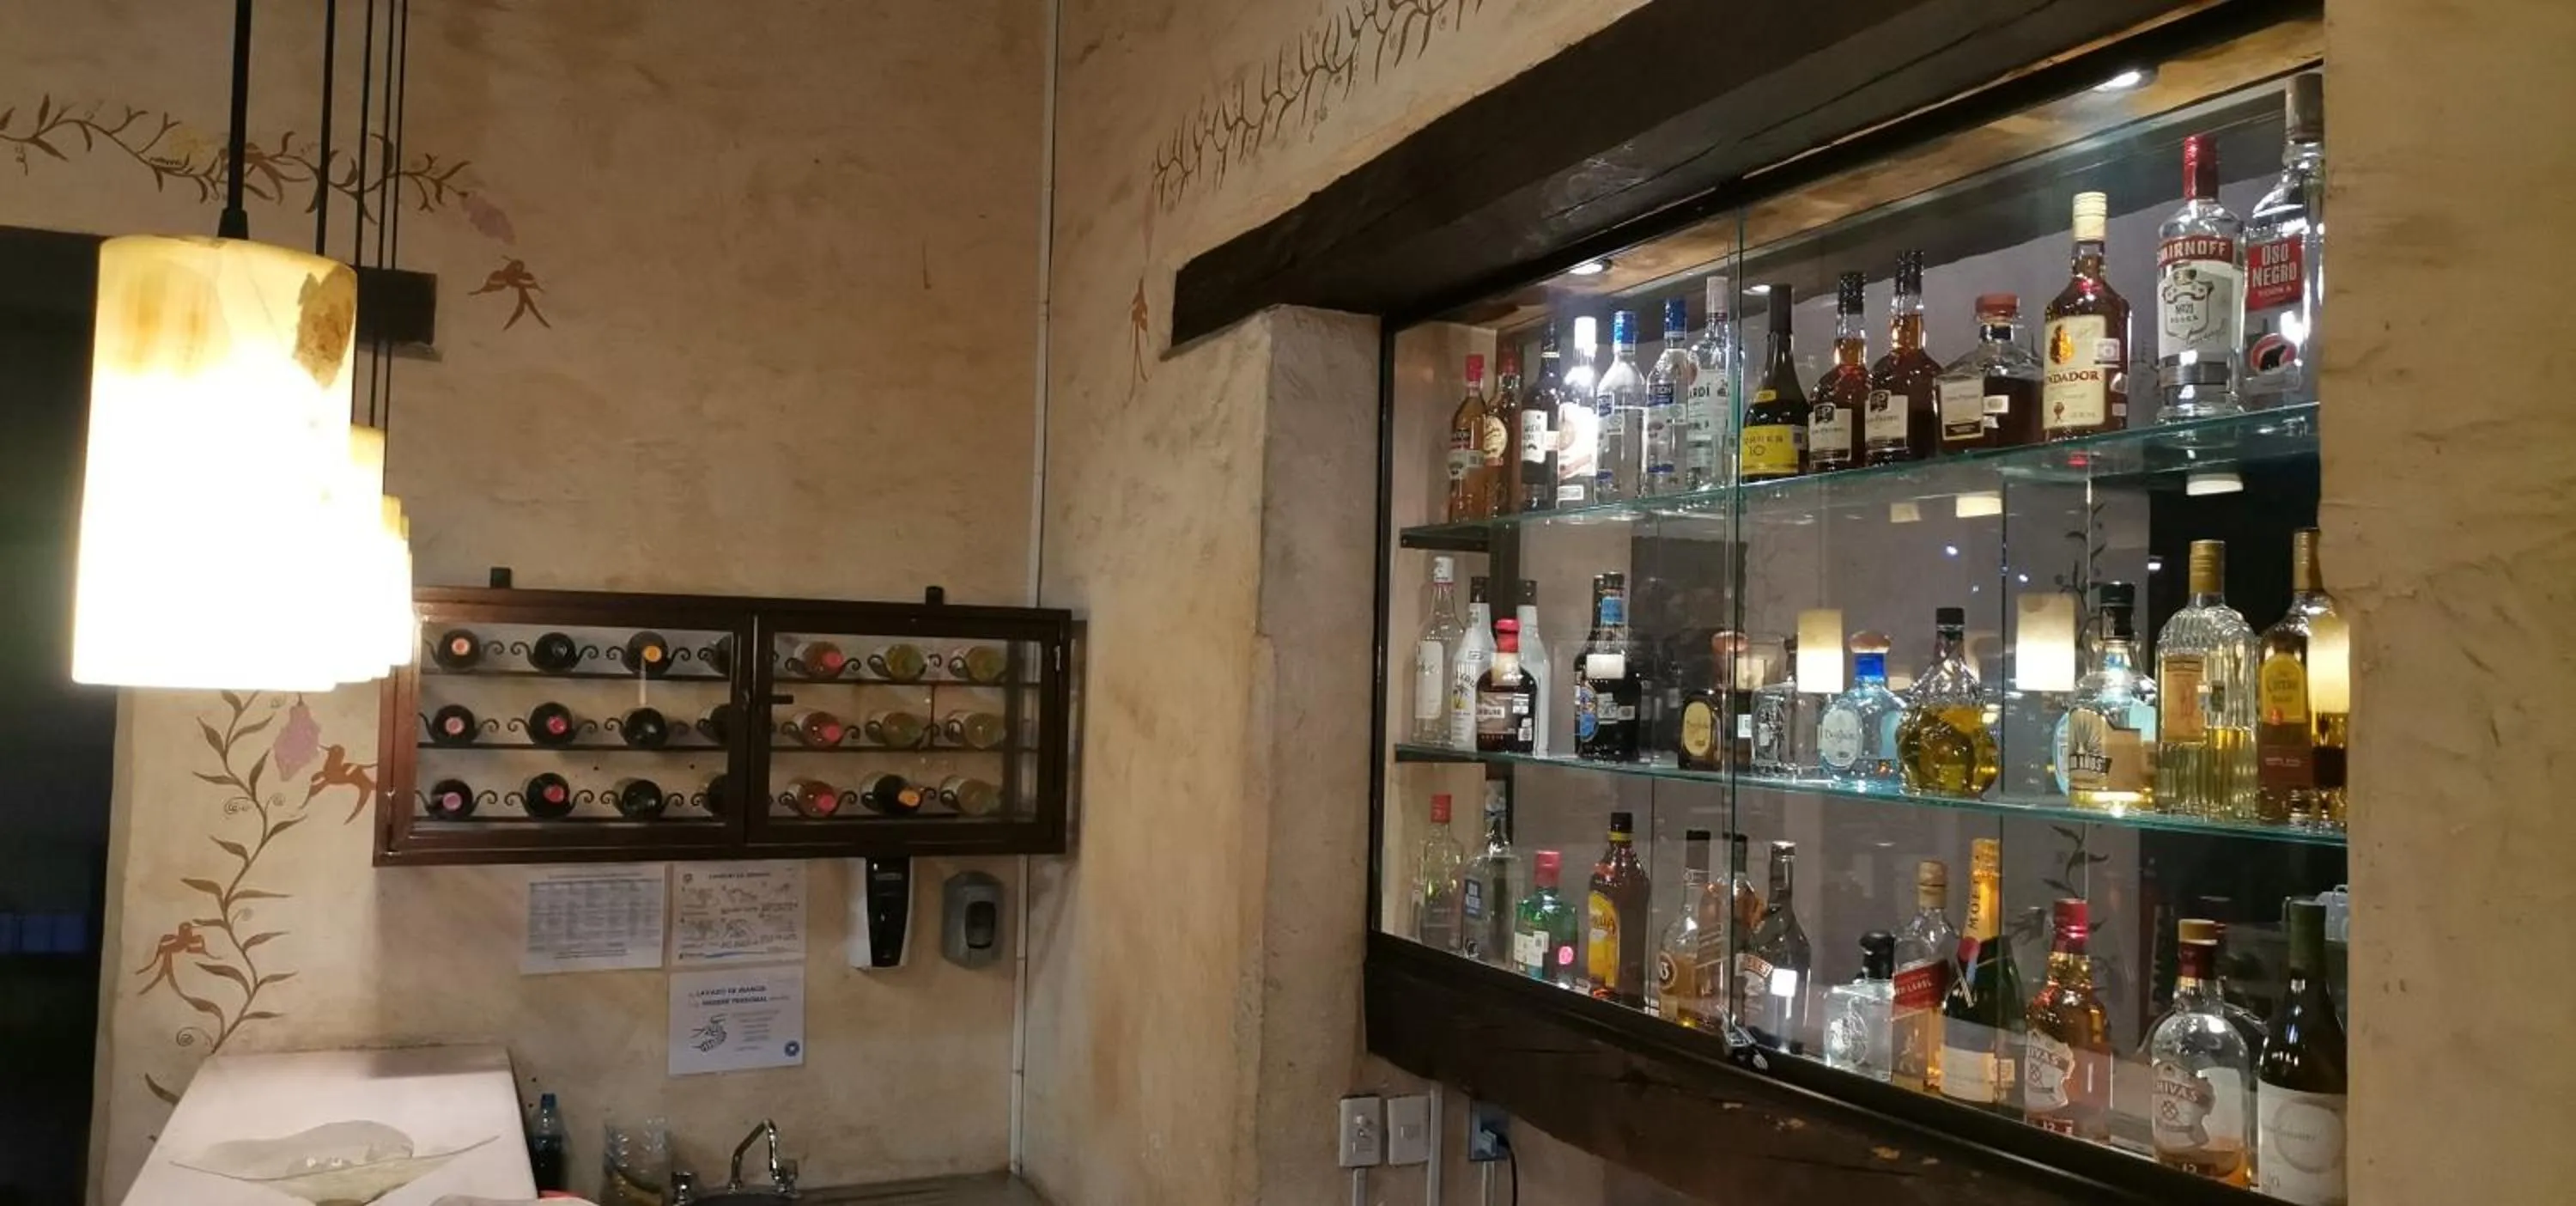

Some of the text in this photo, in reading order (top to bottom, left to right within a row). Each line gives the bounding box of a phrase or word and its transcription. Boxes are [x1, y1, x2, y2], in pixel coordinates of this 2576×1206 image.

[2262, 243, 2288, 265] OSO
[2252, 261, 2297, 288] NEGRO
[1749, 444, 1765, 456] 10
